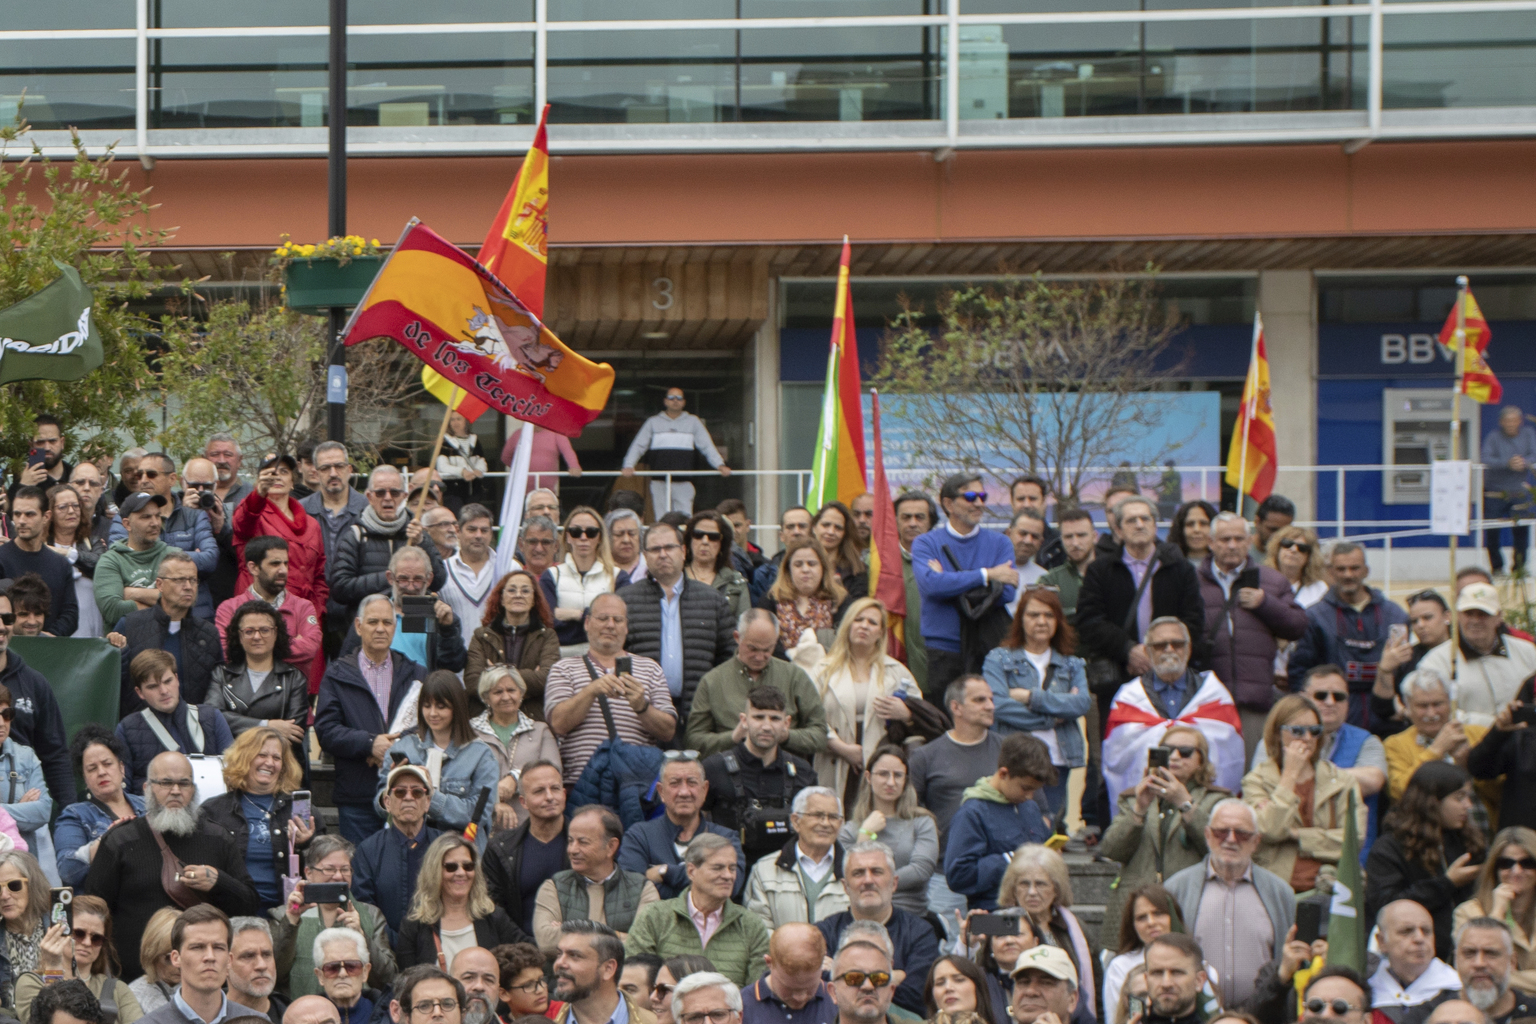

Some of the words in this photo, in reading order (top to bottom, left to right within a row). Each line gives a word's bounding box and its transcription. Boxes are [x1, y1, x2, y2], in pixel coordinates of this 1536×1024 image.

[651, 277, 674, 310] 3
[1381, 333, 1489, 364] BBV
[403, 320, 432, 348] de
[434, 341, 472, 374] los
[475, 372, 553, 417] Tercios
